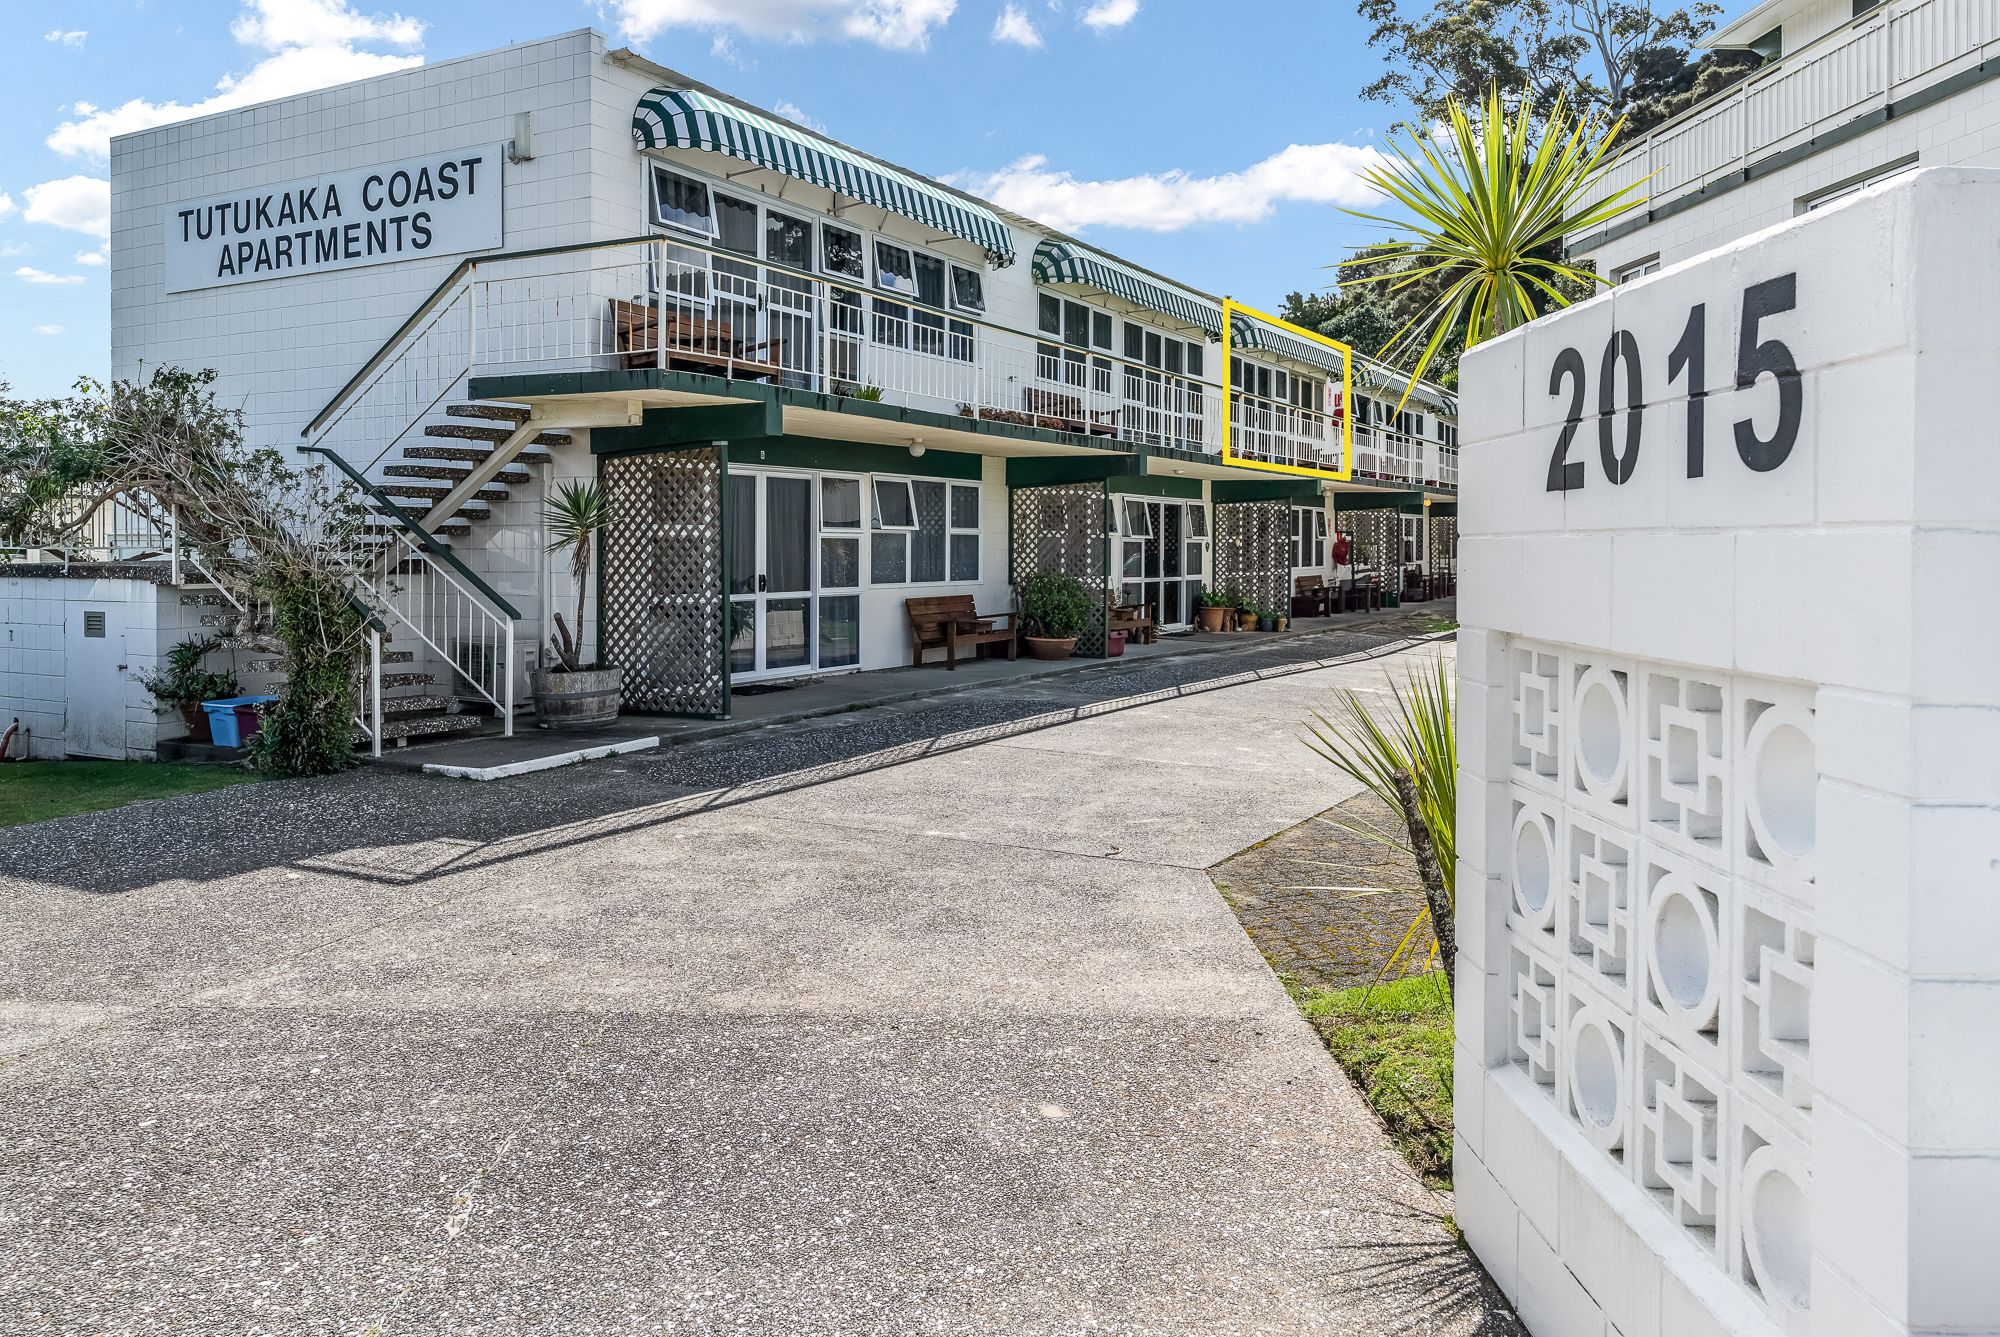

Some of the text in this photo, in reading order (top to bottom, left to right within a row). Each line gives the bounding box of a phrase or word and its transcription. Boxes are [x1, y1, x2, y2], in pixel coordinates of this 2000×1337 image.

[178, 156, 483, 243] TUTUKAKA COAST
[217, 211, 433, 278] APARTMENTS
[1545, 271, 1803, 493] 2015
